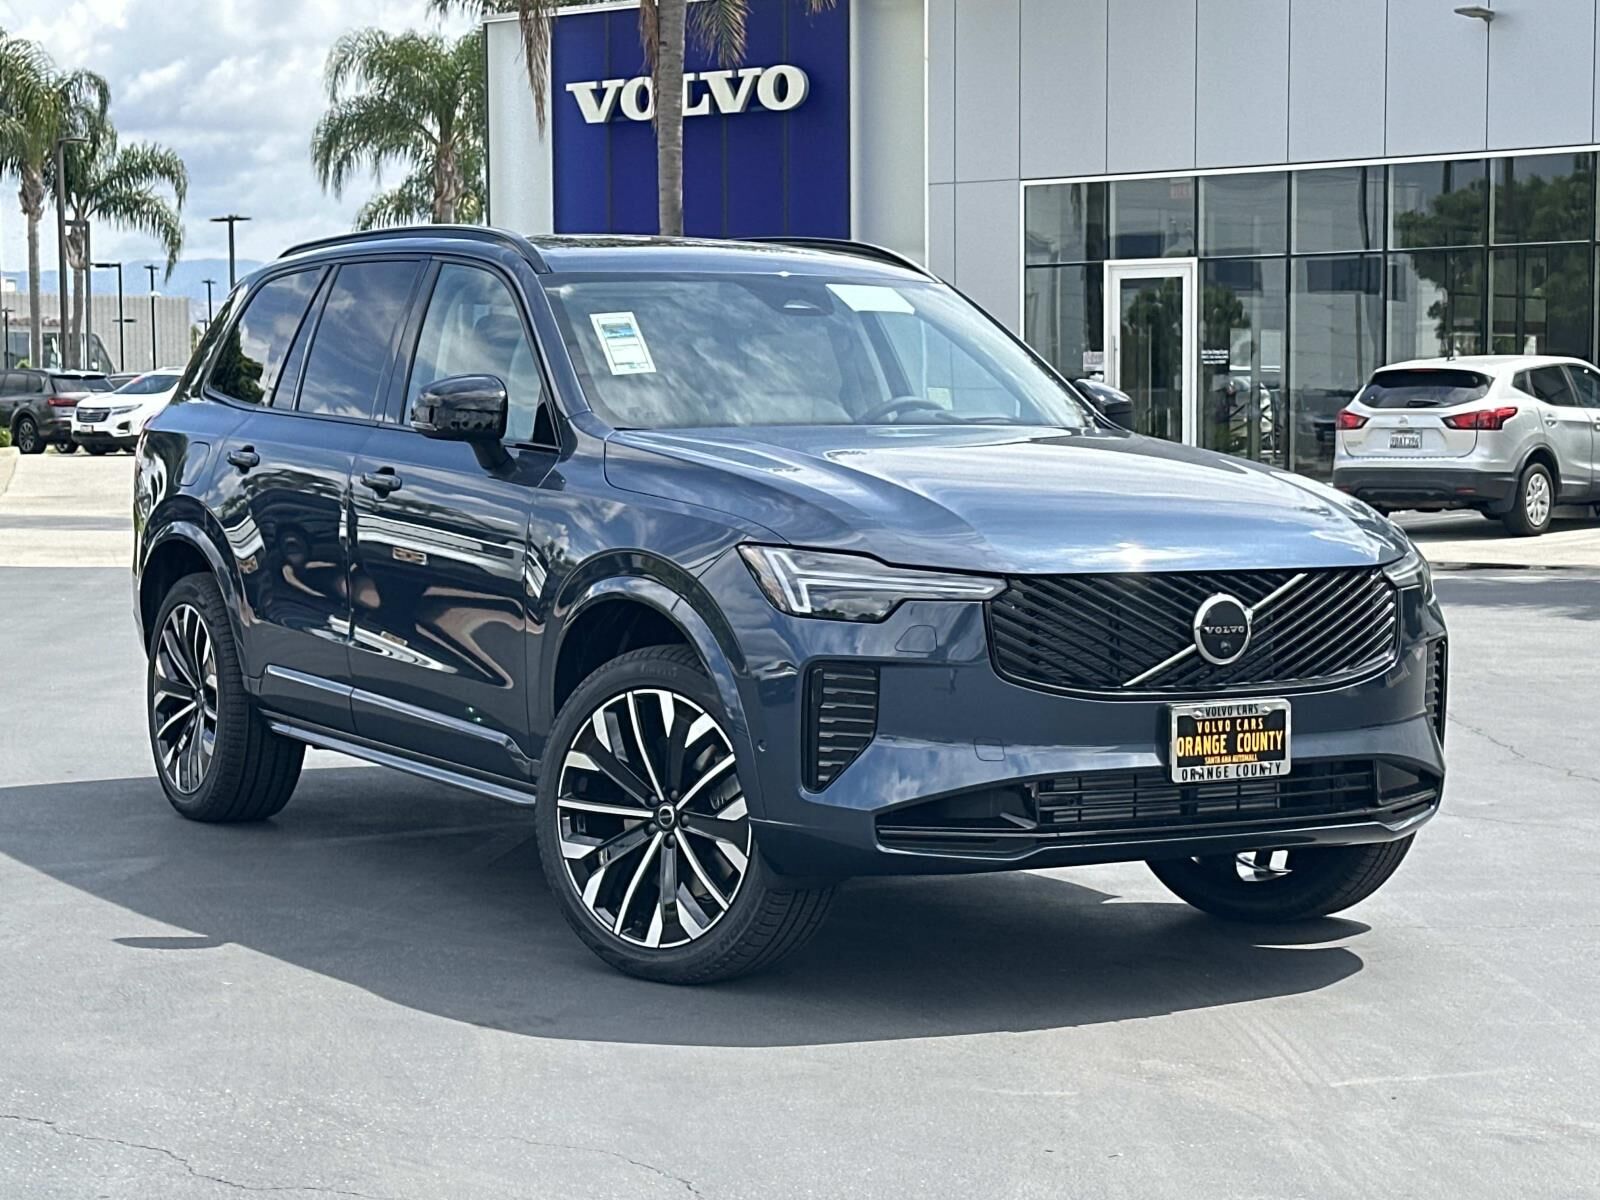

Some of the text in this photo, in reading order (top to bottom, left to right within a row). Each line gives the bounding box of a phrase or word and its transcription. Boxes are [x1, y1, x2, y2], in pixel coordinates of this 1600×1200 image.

[1203, 625, 1245, 634] VOLVO
[1205, 704, 1259, 717] VOLVO CARS
[1197, 717, 1264, 734] VOLVO CARS
[1176, 730, 1283, 757] ORANGE COUNTY
[1181, 762, 1282, 781] ORANGE COUNTY
